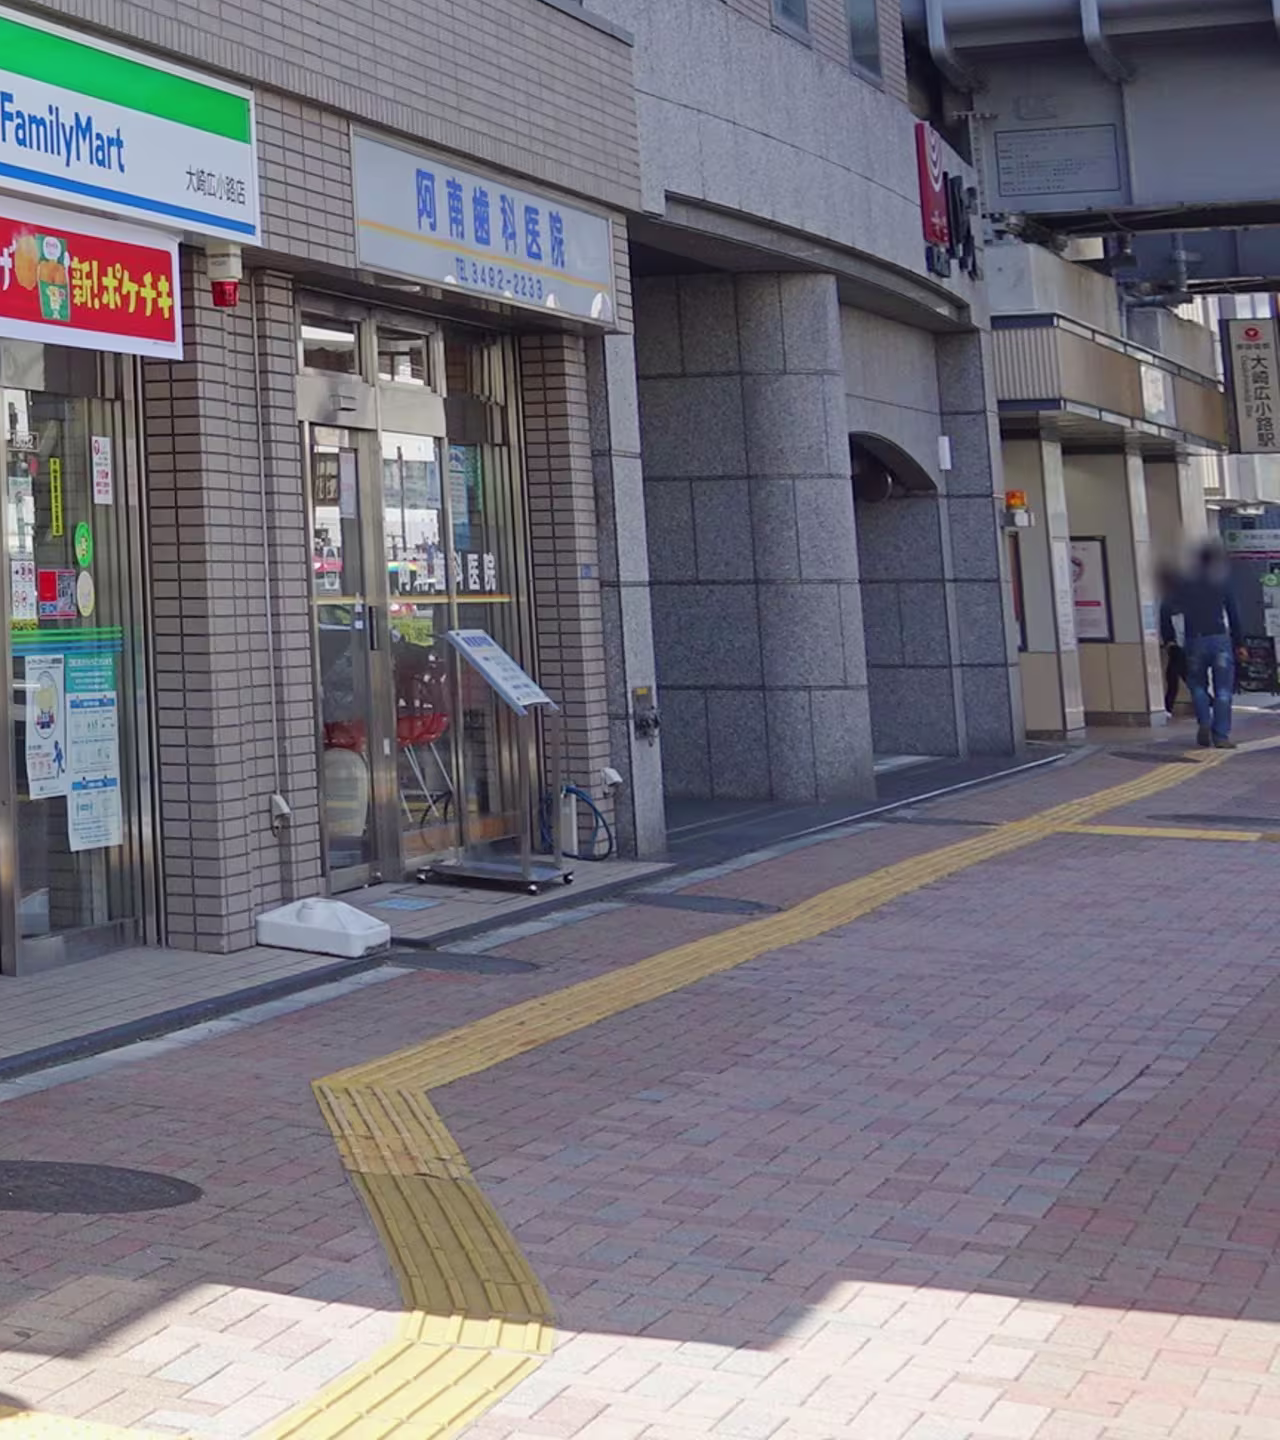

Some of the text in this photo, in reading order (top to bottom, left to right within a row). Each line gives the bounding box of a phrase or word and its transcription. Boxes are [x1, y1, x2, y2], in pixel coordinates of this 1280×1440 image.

[0, 91, 126, 173] FamilyMart
[185, 168, 247, 208] 大崎広小路店
[416, 168, 565, 268] 阿南歯科医院
[472, 262, 544, 300] 3492-2233
